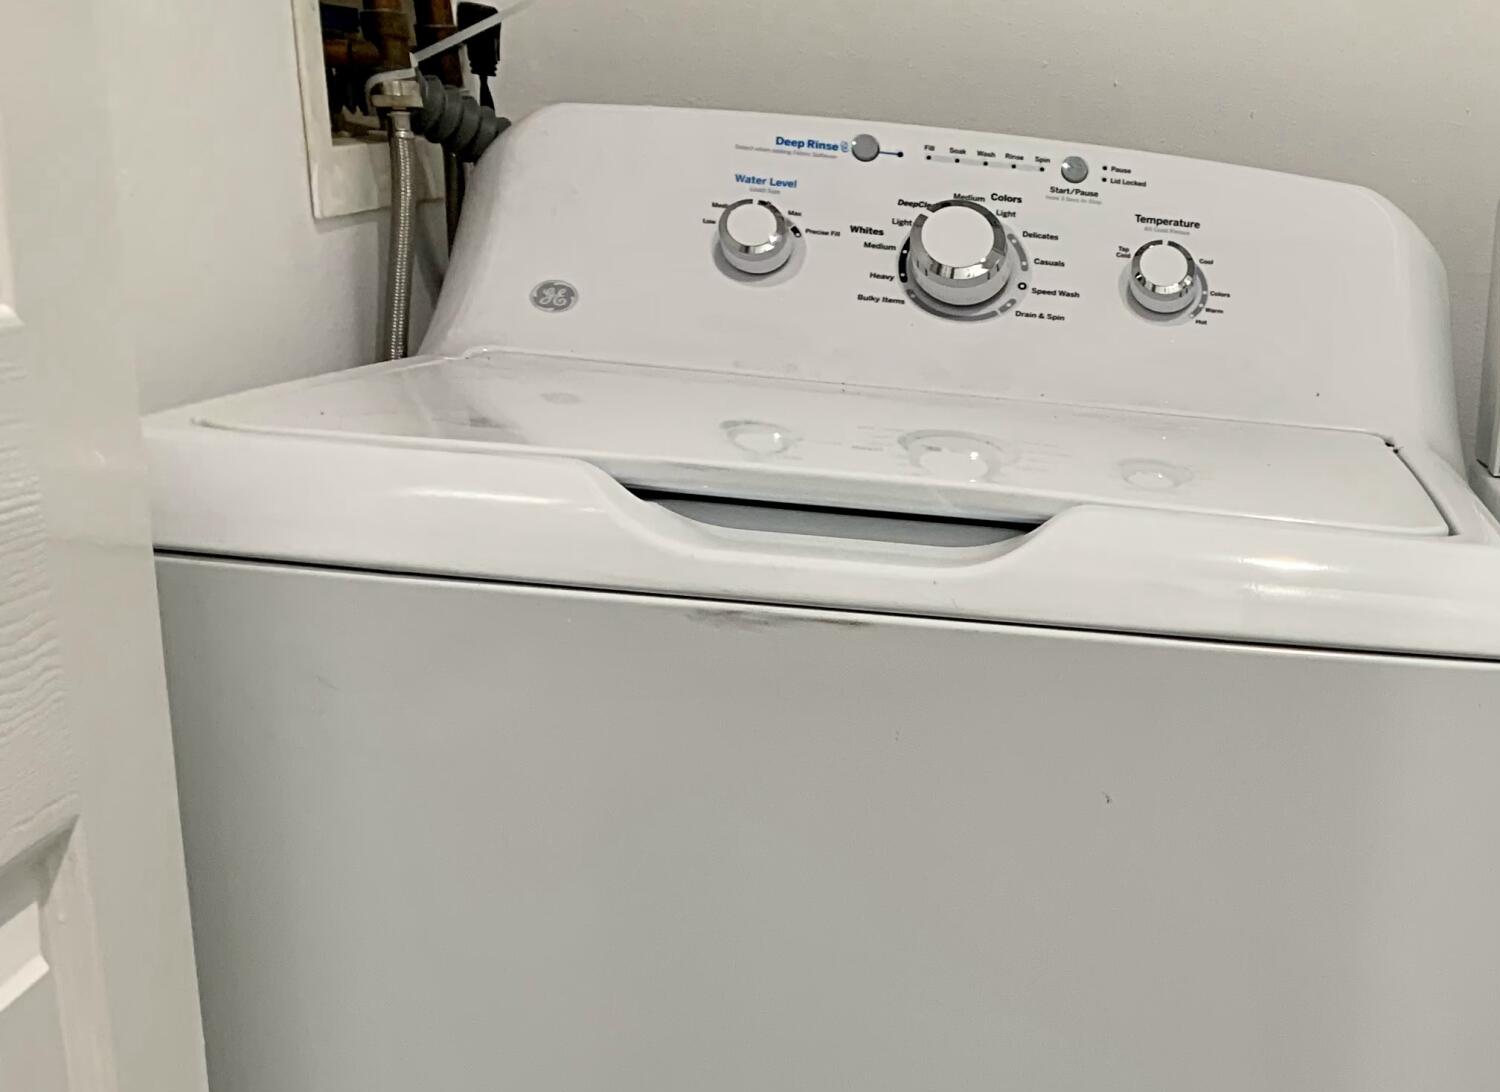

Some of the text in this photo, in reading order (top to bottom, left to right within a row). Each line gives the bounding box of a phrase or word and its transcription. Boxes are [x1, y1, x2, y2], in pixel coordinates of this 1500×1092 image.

[775, 136, 805, 149] Deep
[807, 139, 839, 151] Rinse
[977, 150, 996, 158] Wash
[1005, 153, 1024, 161] Rinse
[1111, 166, 1132, 174] Pause
[735, 173, 797, 188] Water Level
[1122, 179, 1147, 188] Locked
[1049, 186, 1099, 198] Start/Pause
[953, 193, 986, 203] Medium
[990, 192, 1022, 204] Colors
[995, 209, 1017, 219] Light
[891, 218, 913, 227] Light
[1134, 214, 1201, 230] Temperature
[805, 228, 830, 237] Precise
[849, 225, 885, 237] Whites
[1022, 230, 1059, 241] Delicates
[863, 241, 897, 251] Medium
[1033, 258, 1066, 268] Casuals
[869, 272, 896, 282] Heavy
[1031, 287, 1080, 299] Speed Wash
[1209, 290, 1231, 298] Colors
[857, 294, 906, 305] Bulky Items
[1015, 310, 1066, 322] Drain & Spin
